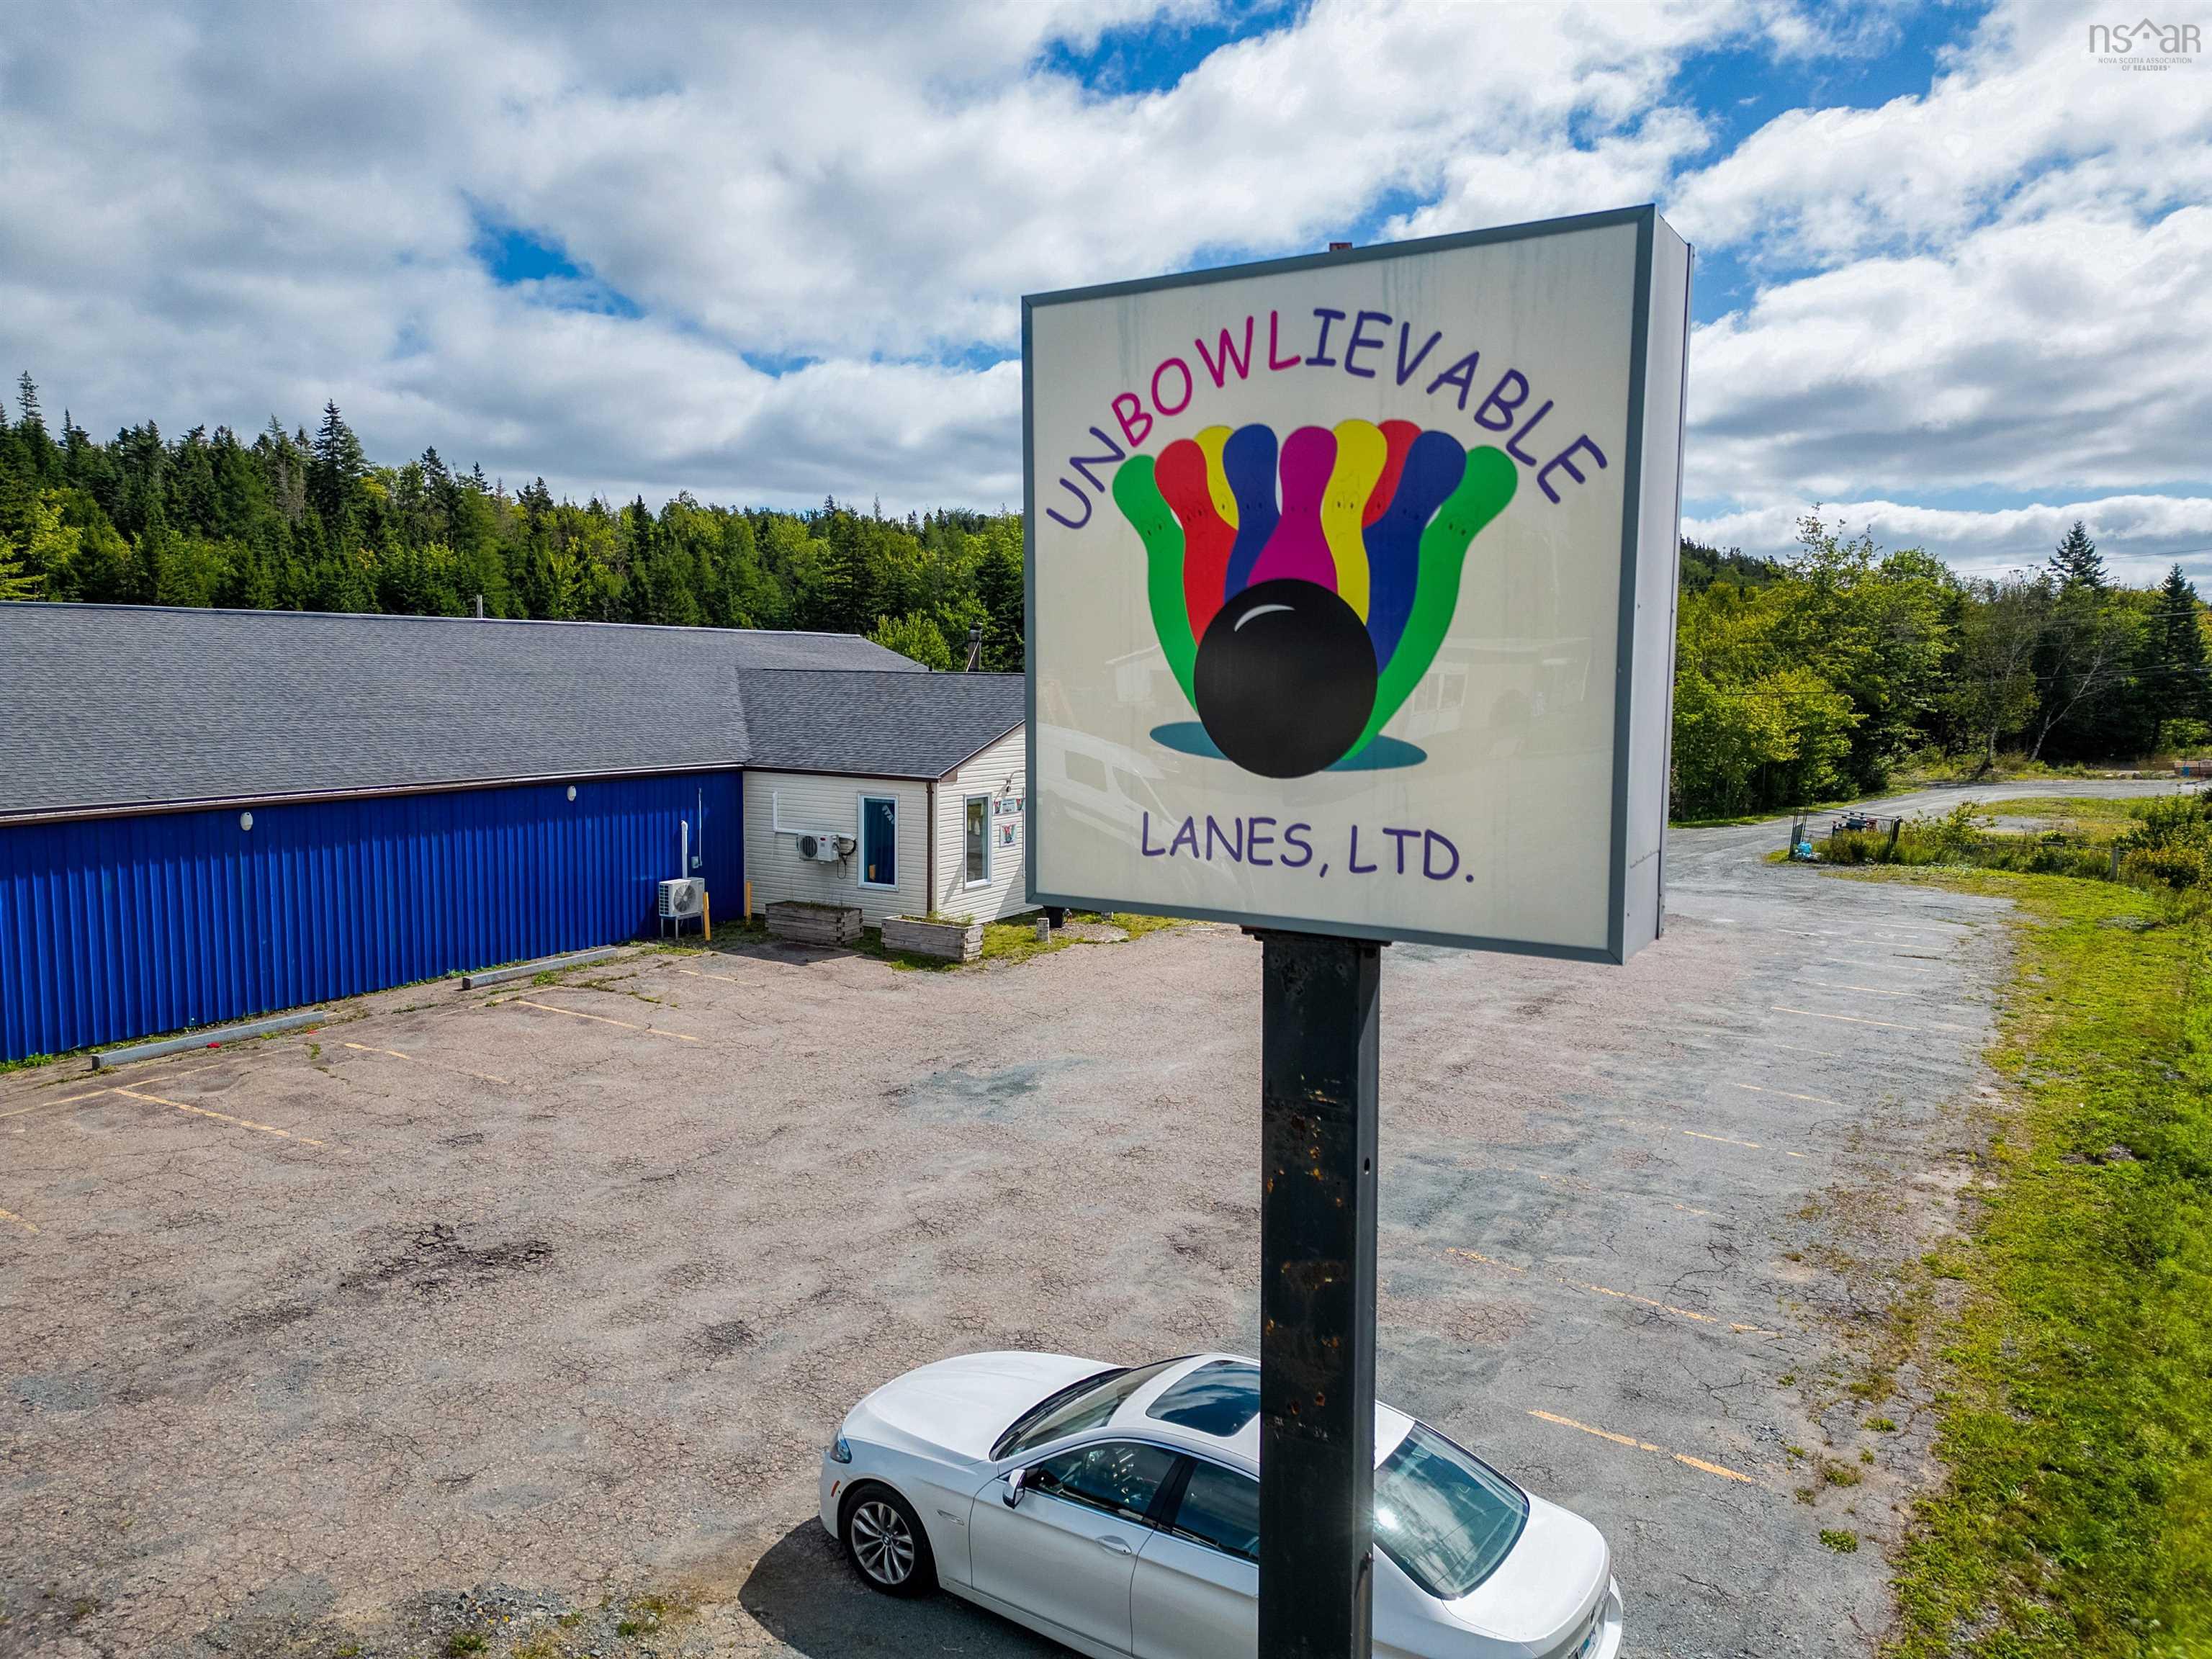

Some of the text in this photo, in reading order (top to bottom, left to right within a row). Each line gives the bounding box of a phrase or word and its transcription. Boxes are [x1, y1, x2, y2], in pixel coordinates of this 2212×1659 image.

[1046, 308, 1609, 529] UNBOWLIEVABLE
[1141, 811, 1475, 883] LANES, LTD.
